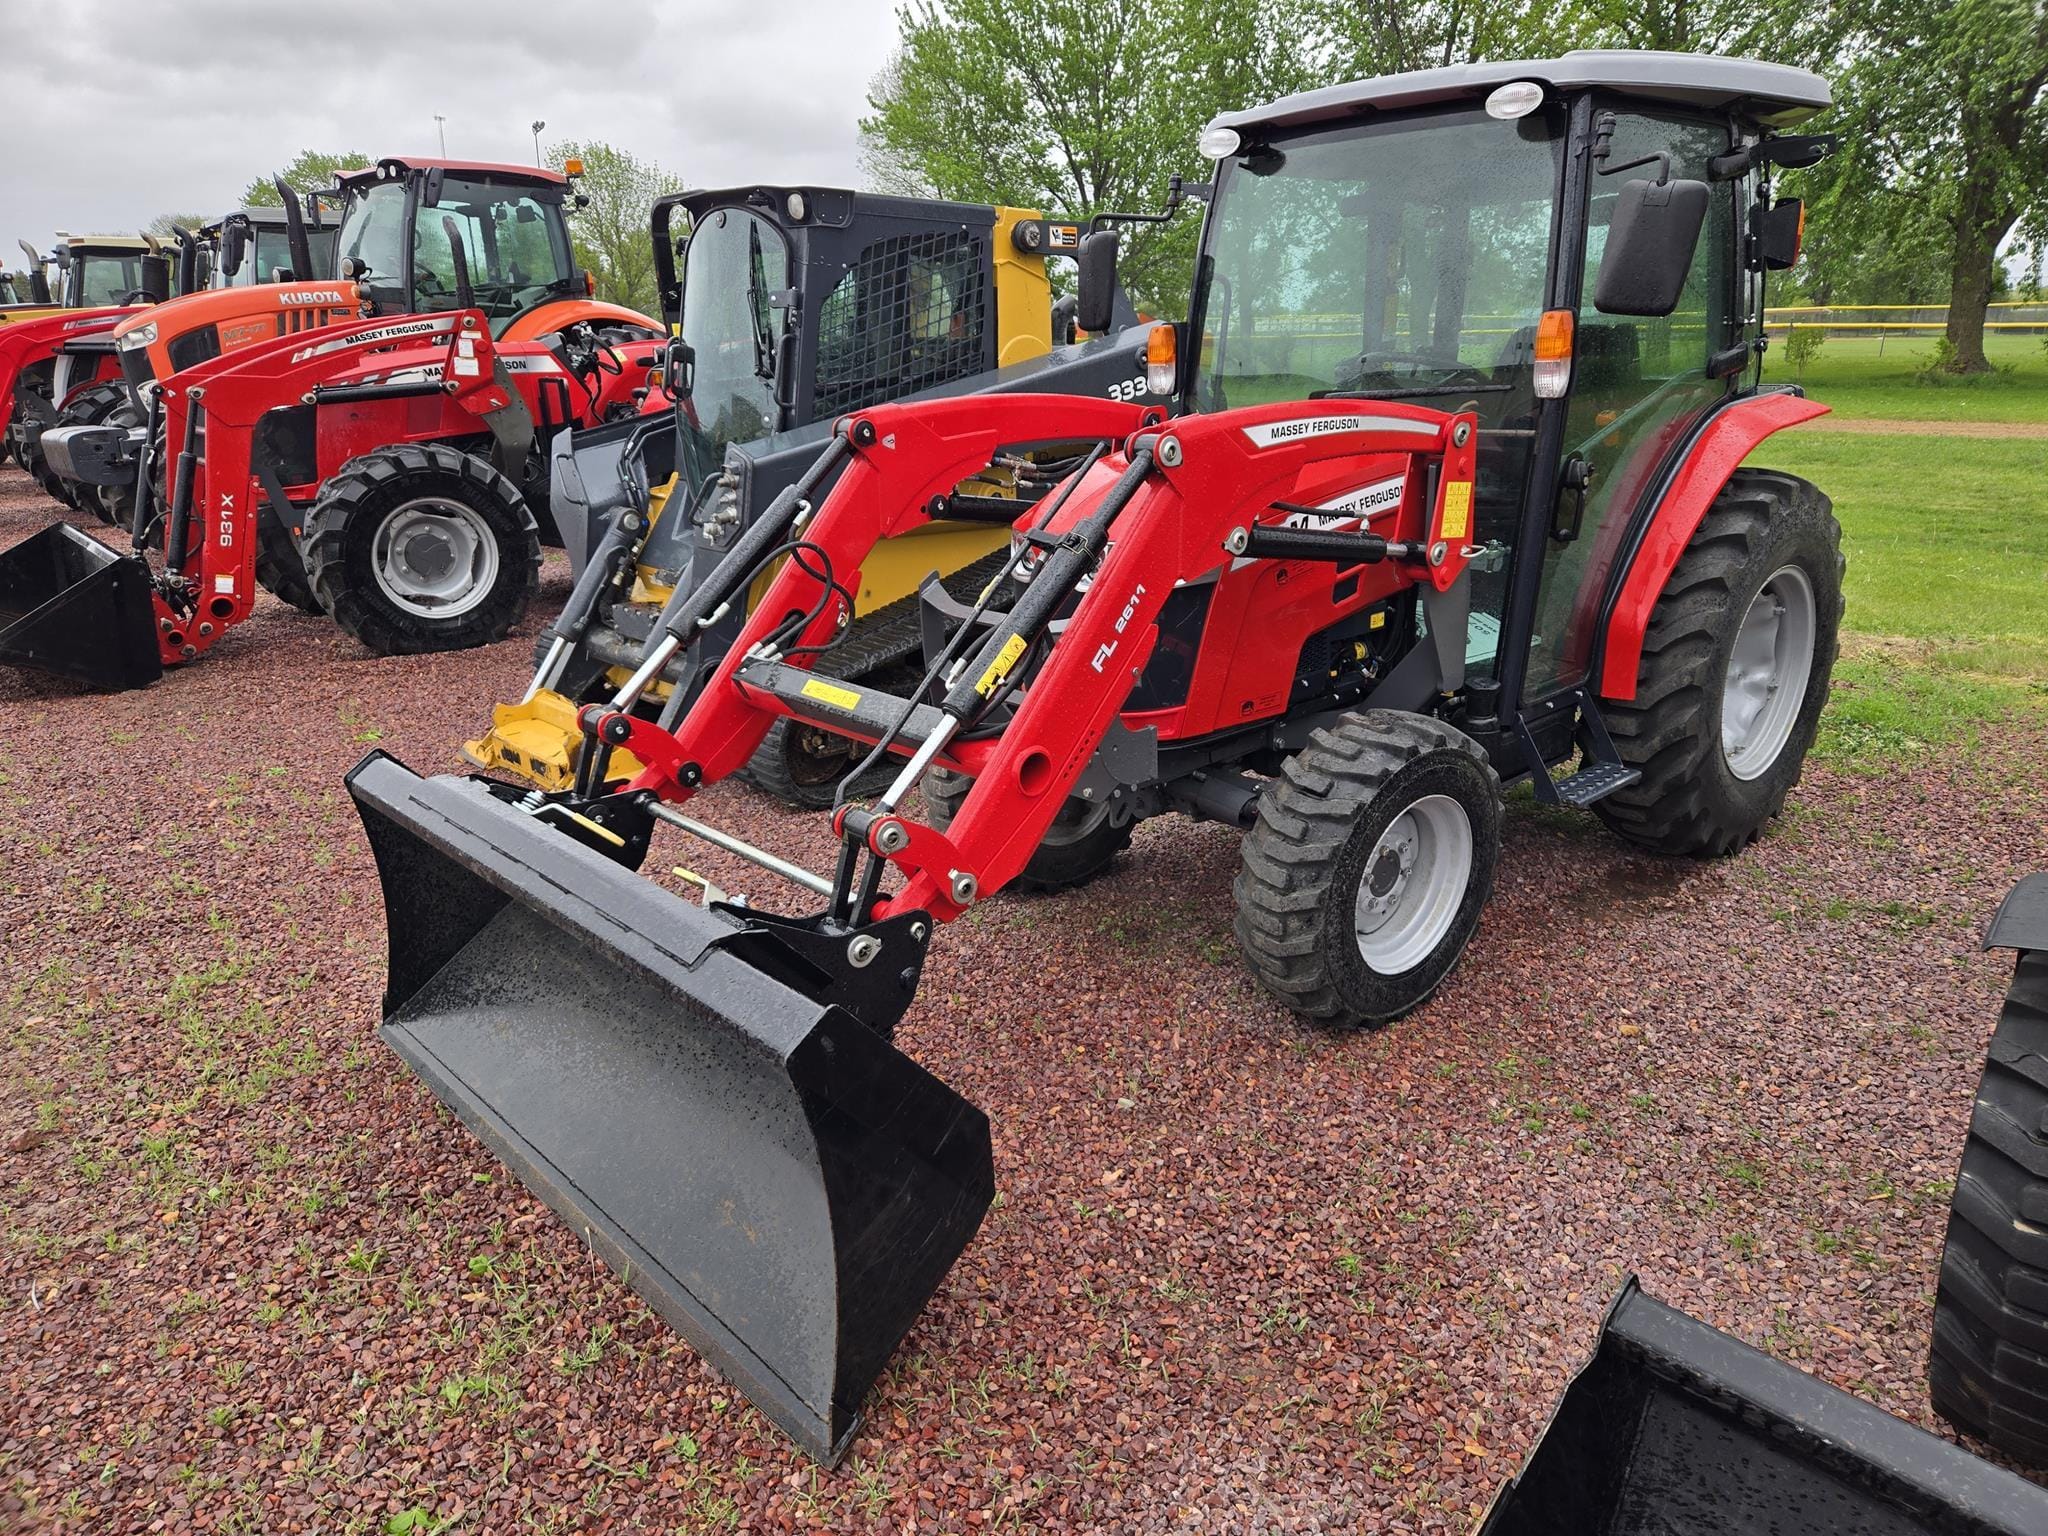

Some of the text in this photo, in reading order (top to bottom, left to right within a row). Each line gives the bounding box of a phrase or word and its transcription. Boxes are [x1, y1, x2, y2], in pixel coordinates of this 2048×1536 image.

[279, 291, 343, 305] KUBOTA
[345, 323, 434, 345] MASSEY FERGUSON
[504, 360, 527, 370] SON
[1108, 376, 1151, 403] 333
[1271, 418, 1360, 439] MASSEY FERGUSON
[1091, 583, 1146, 673] FL 2611
